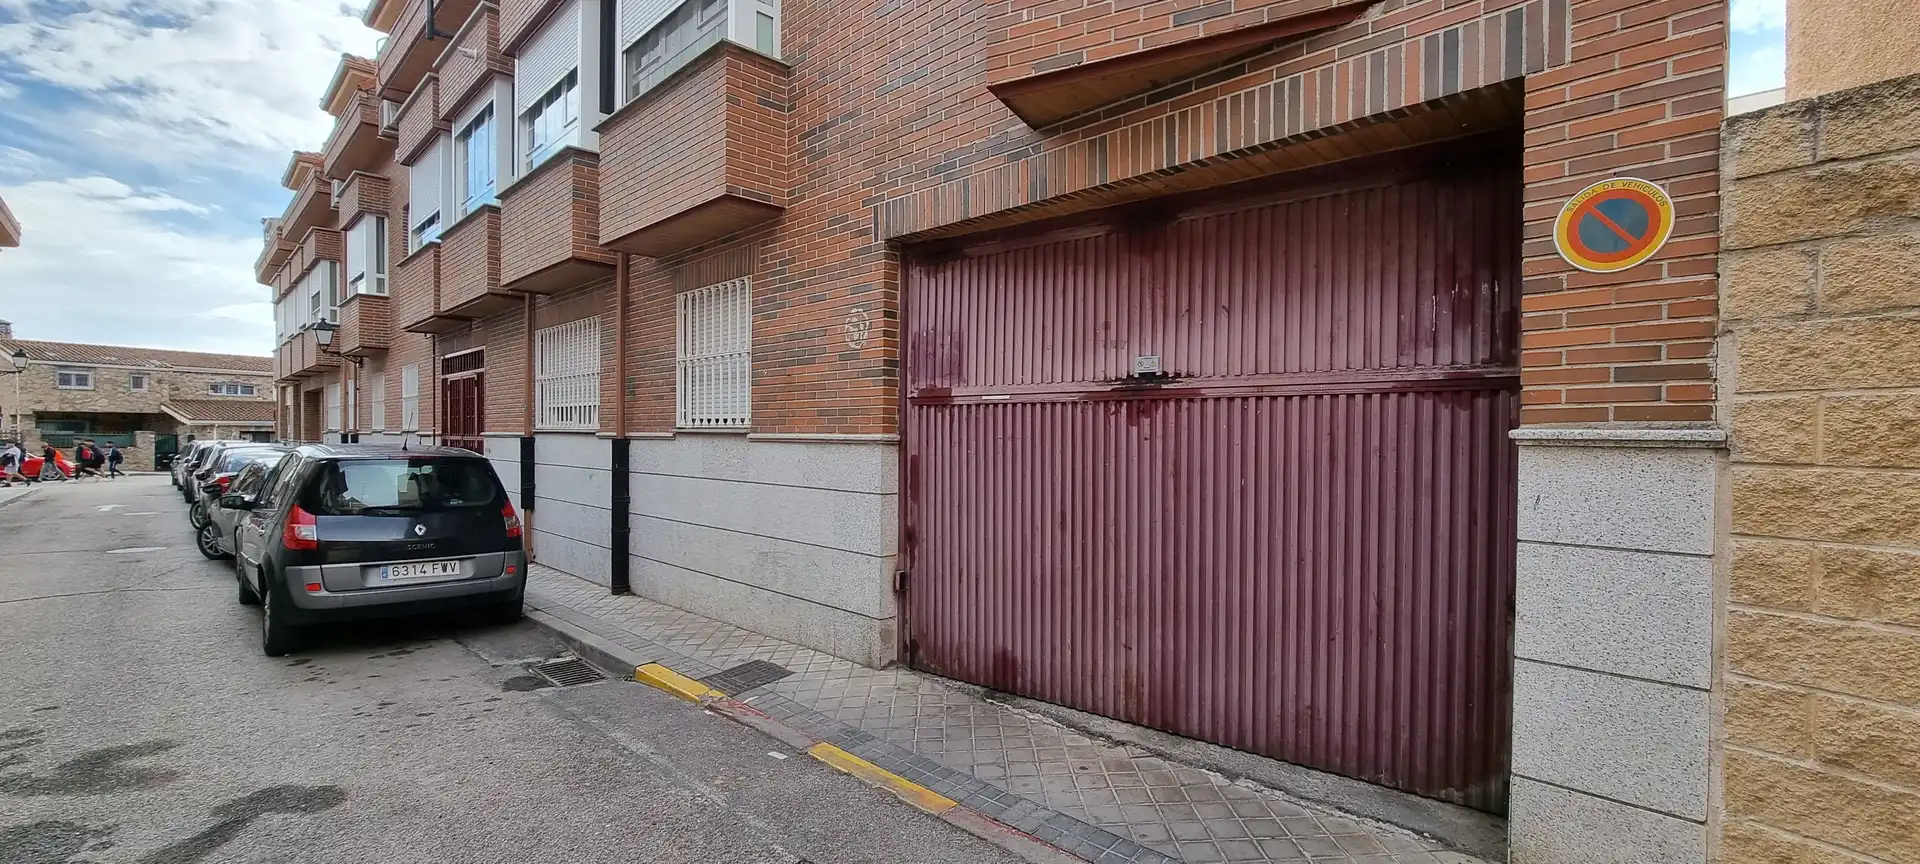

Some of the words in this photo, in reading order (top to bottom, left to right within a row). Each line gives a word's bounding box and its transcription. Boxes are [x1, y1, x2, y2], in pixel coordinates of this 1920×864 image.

[1567, 189, 1598, 212] SALIDA
[1603, 182, 1616, 190] DE
[1621, 181, 1668, 207] VEHICULOS
[407, 543, 436, 551] SCENIC
[392, 564, 427, 577] 6314
[432, 562, 457, 574] FWV
